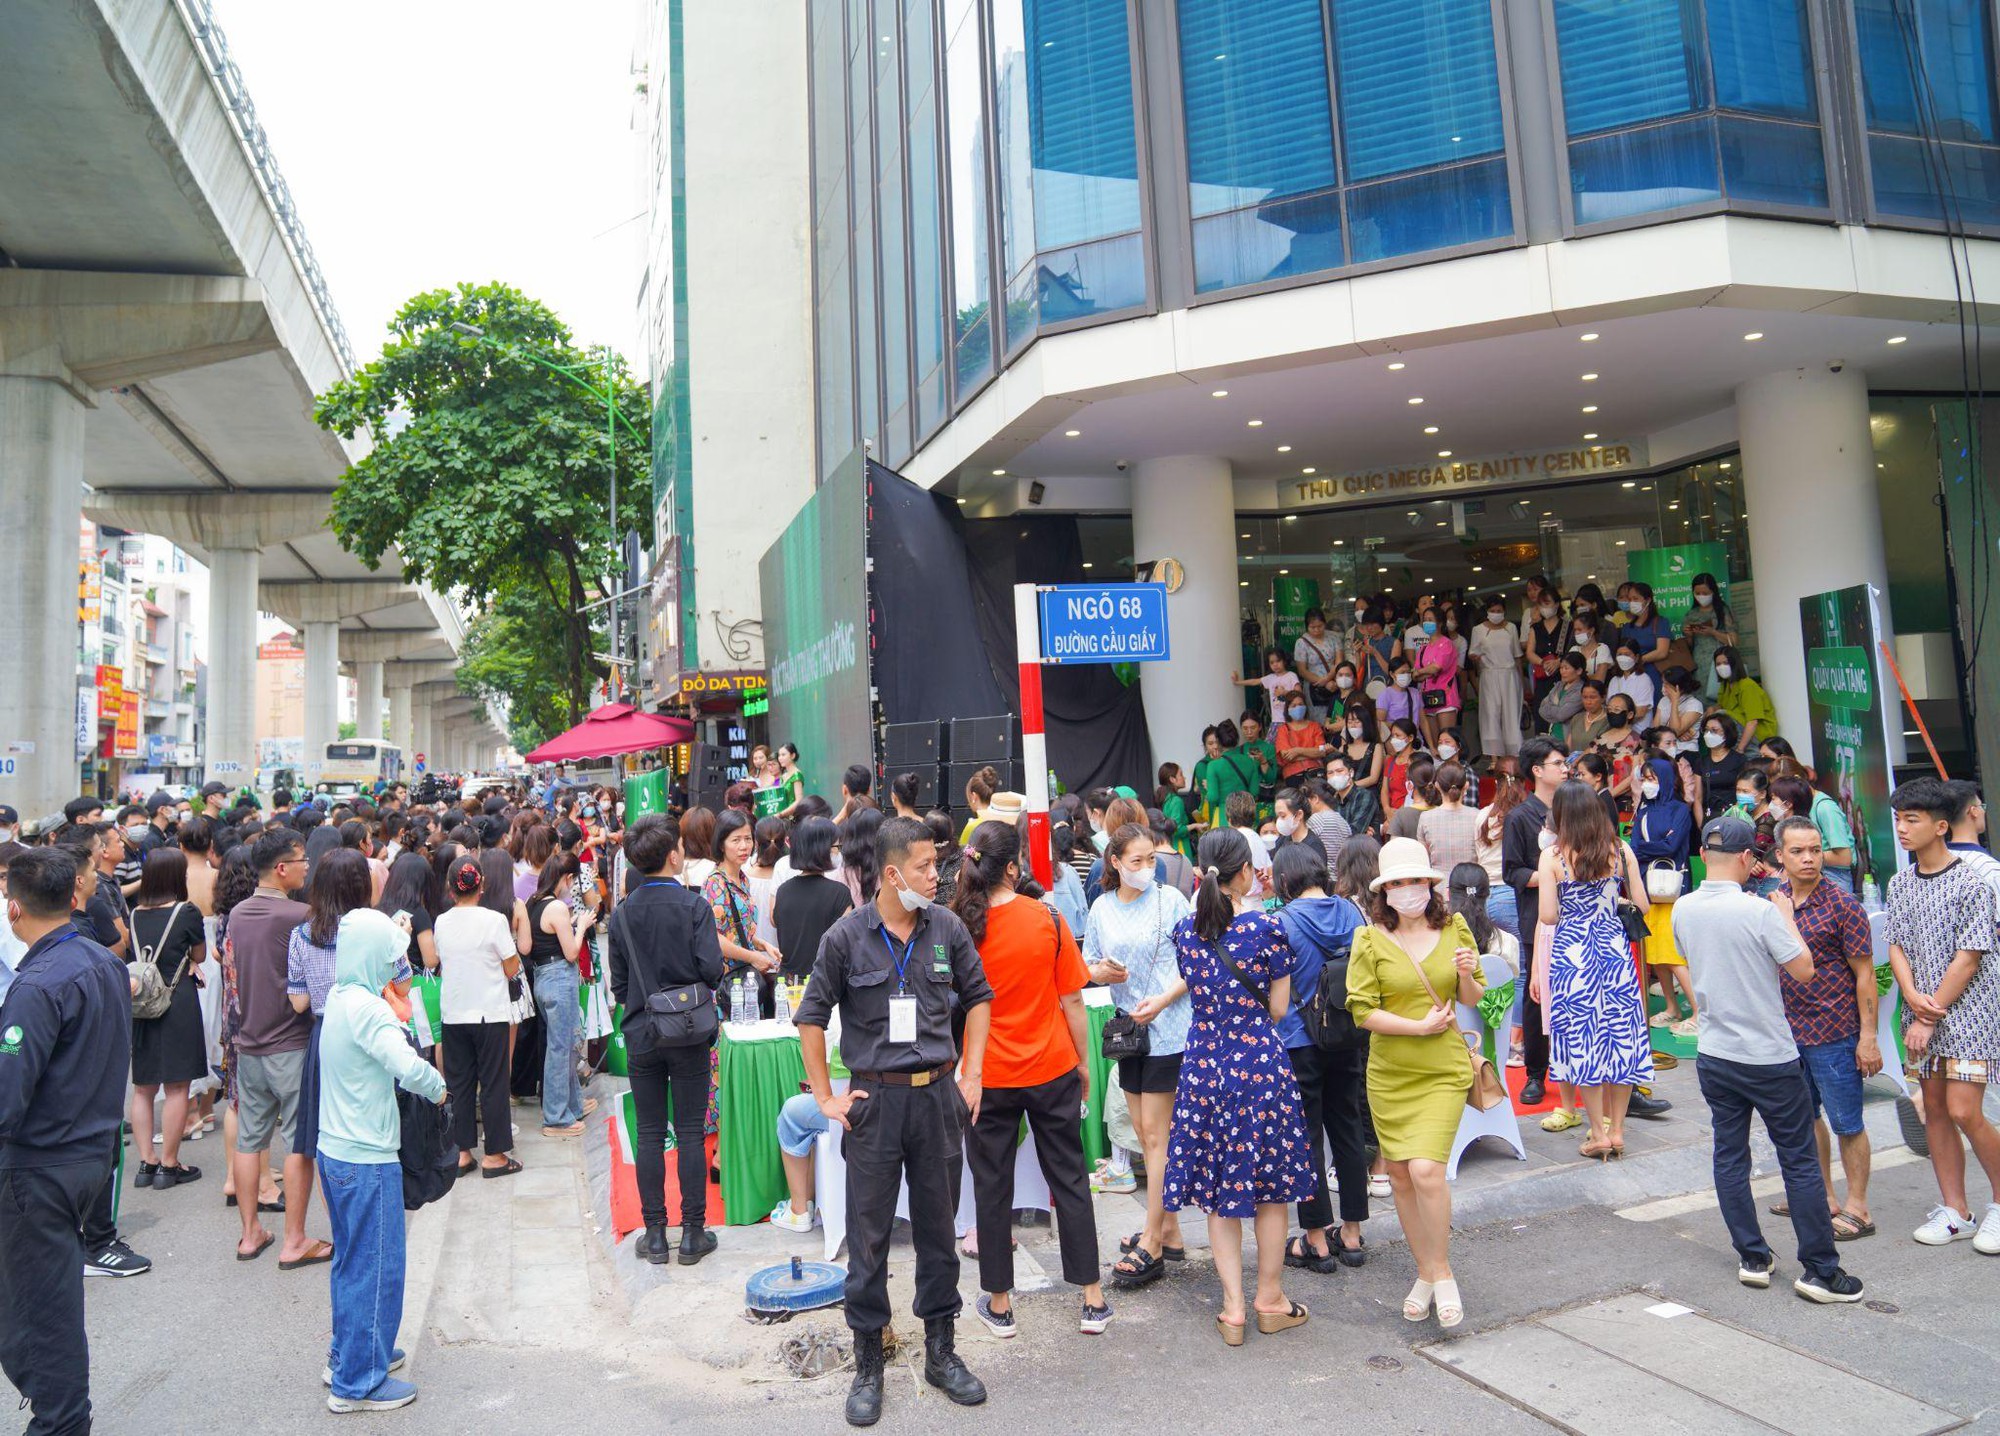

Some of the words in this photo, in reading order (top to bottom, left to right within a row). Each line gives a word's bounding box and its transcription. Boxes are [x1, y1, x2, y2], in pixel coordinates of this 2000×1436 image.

[1296, 479, 1338, 500] THU
[1388, 467, 1447, 488] MEGA
[1452, 454, 1537, 483] BEAUTY
[1543, 446, 1631, 471] CENTER
[1067, 592, 1114, 620] NGÕ
[1120, 597, 1142, 619] 68
[1670, 594, 1690, 608] PHÍ
[1055, 629, 1098, 653] ĐƯỜNG
[1101, 626, 1126, 652] CẦU
[1129, 626, 1156, 651] GIẤY
[682, 673, 706, 691] ĐỒ
[709, 678, 731, 690] DA
